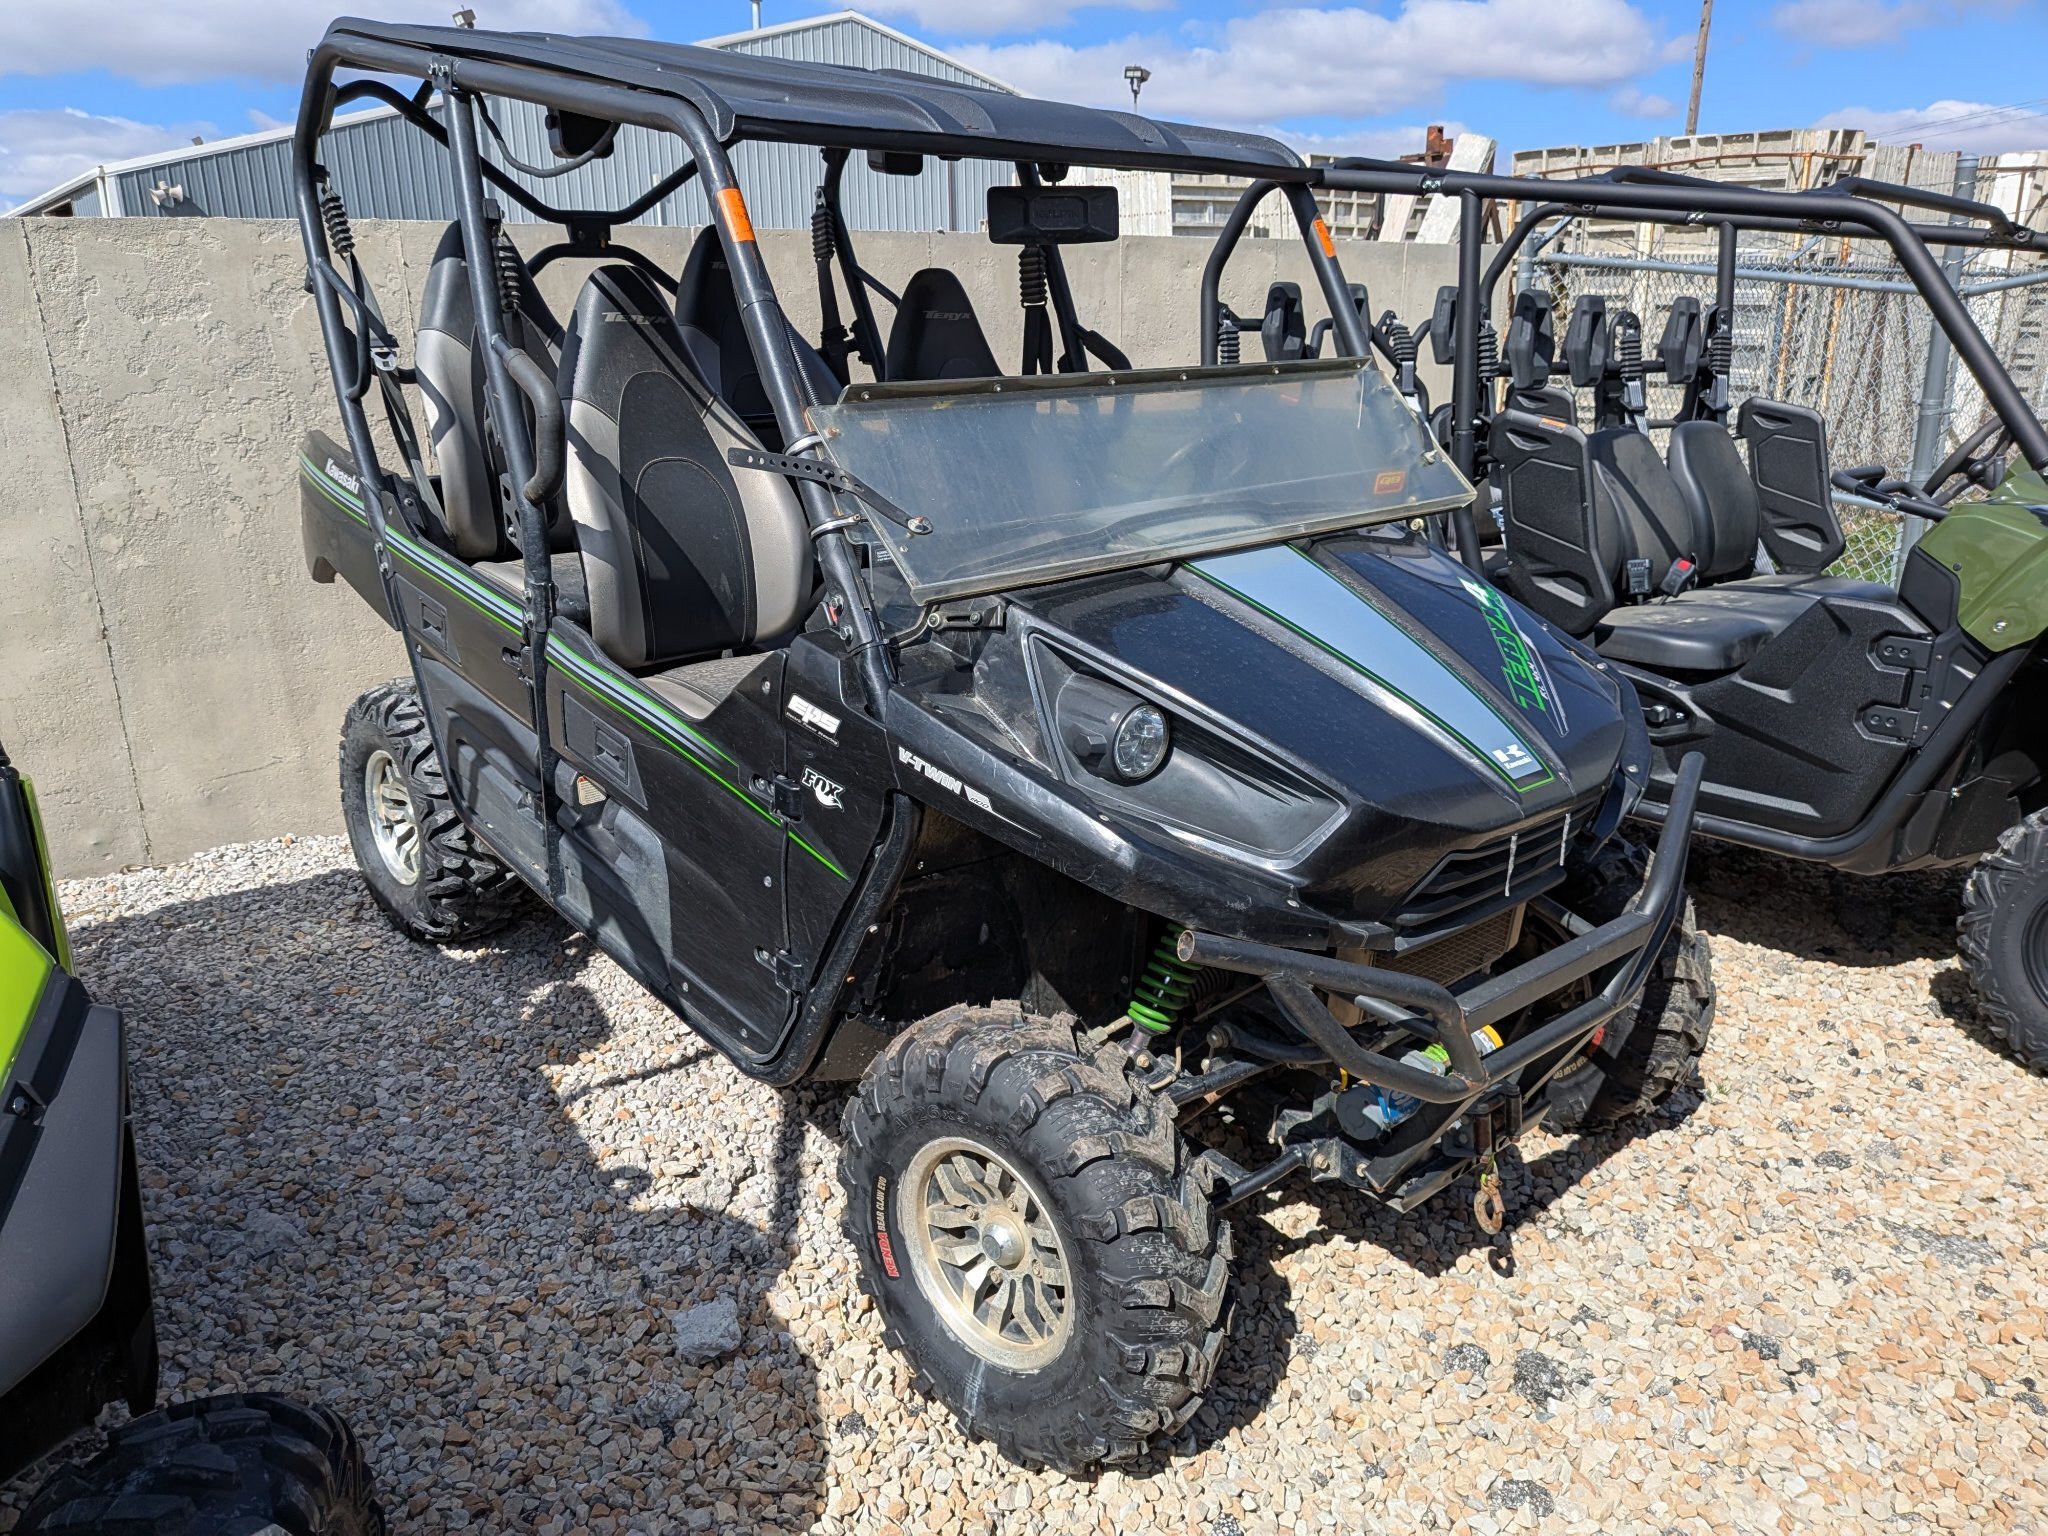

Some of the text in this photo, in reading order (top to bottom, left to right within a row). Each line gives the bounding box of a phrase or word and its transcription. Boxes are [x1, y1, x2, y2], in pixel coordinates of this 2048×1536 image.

[325, 457, 360, 495] Kawasaki
[787, 694, 841, 734] EPS
[801, 767, 844, 803] FOX
[898, 746, 963, 795] V-TWIN
[875, 1175, 901, 1278] KENDA BEAR CLAW EVO
